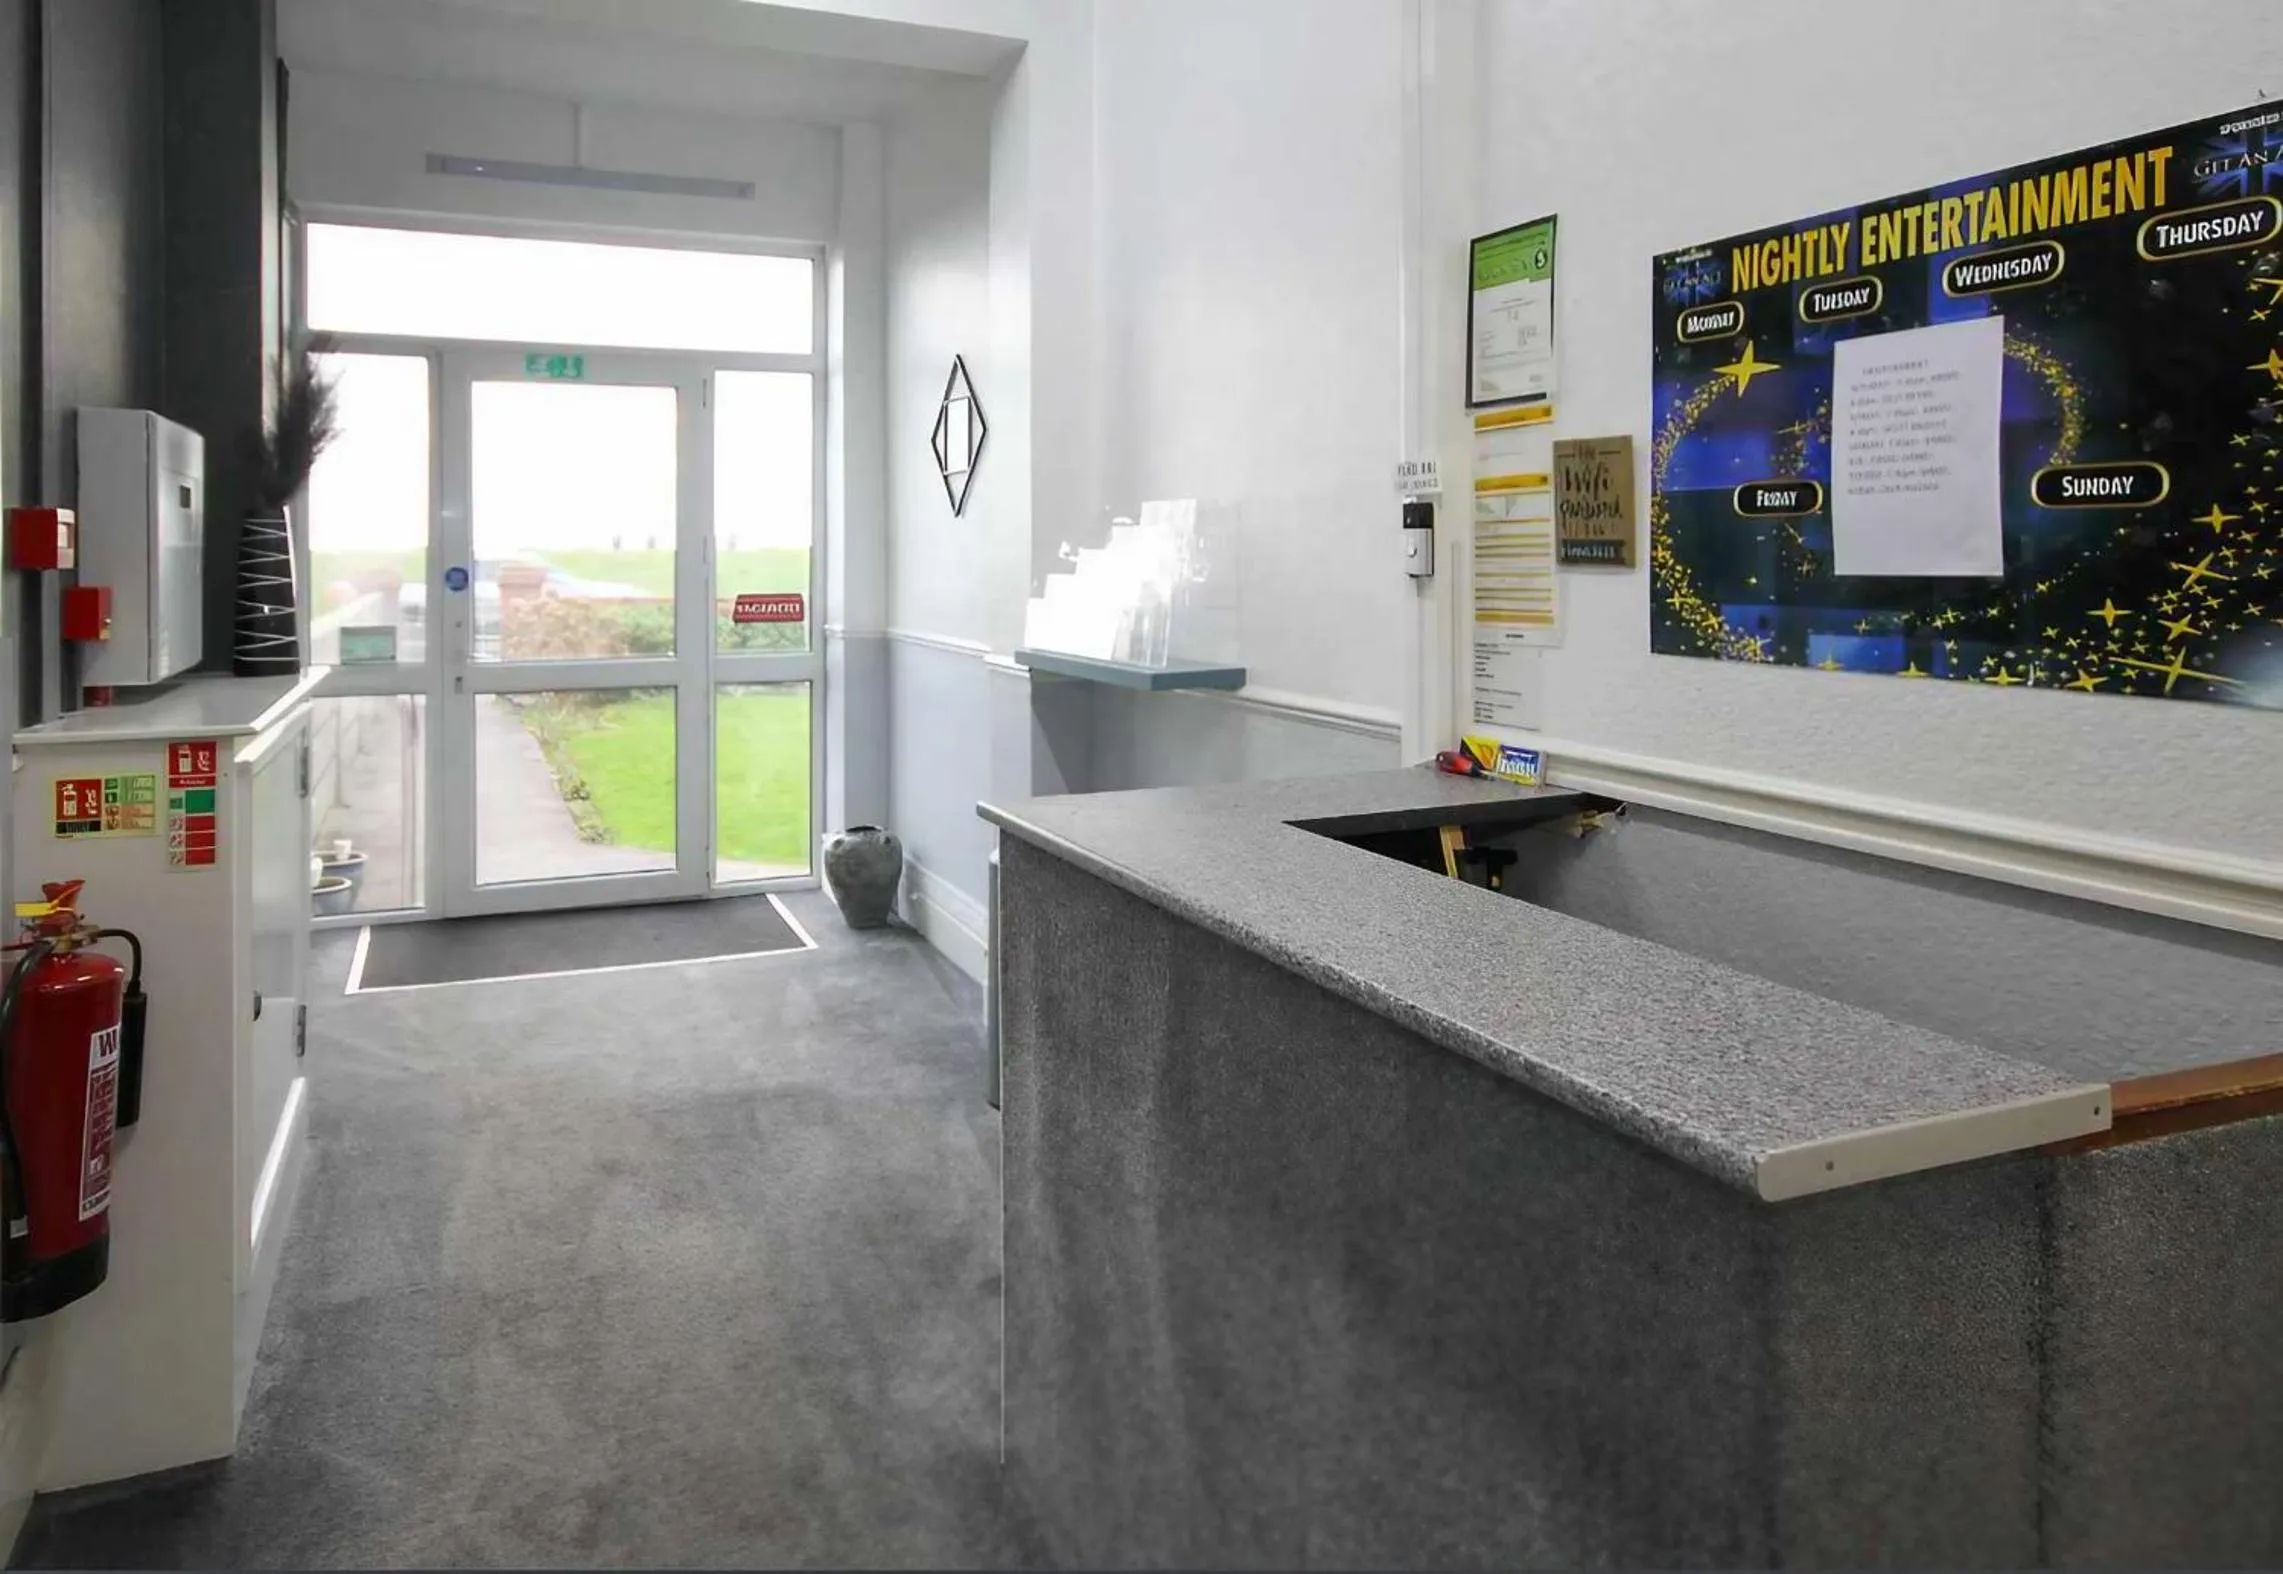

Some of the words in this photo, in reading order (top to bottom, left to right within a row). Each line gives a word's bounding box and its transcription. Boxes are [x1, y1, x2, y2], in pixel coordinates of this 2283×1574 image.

[1731, 221, 1851, 294] NIGHTLY
[1861, 145, 2173, 267] ENTERTAINMENT
[2155, 210, 2264, 249] THURSDAY
[1954, 252, 2053, 288] WEDNESDAY
[2061, 475, 2134, 498] SUNDAY
